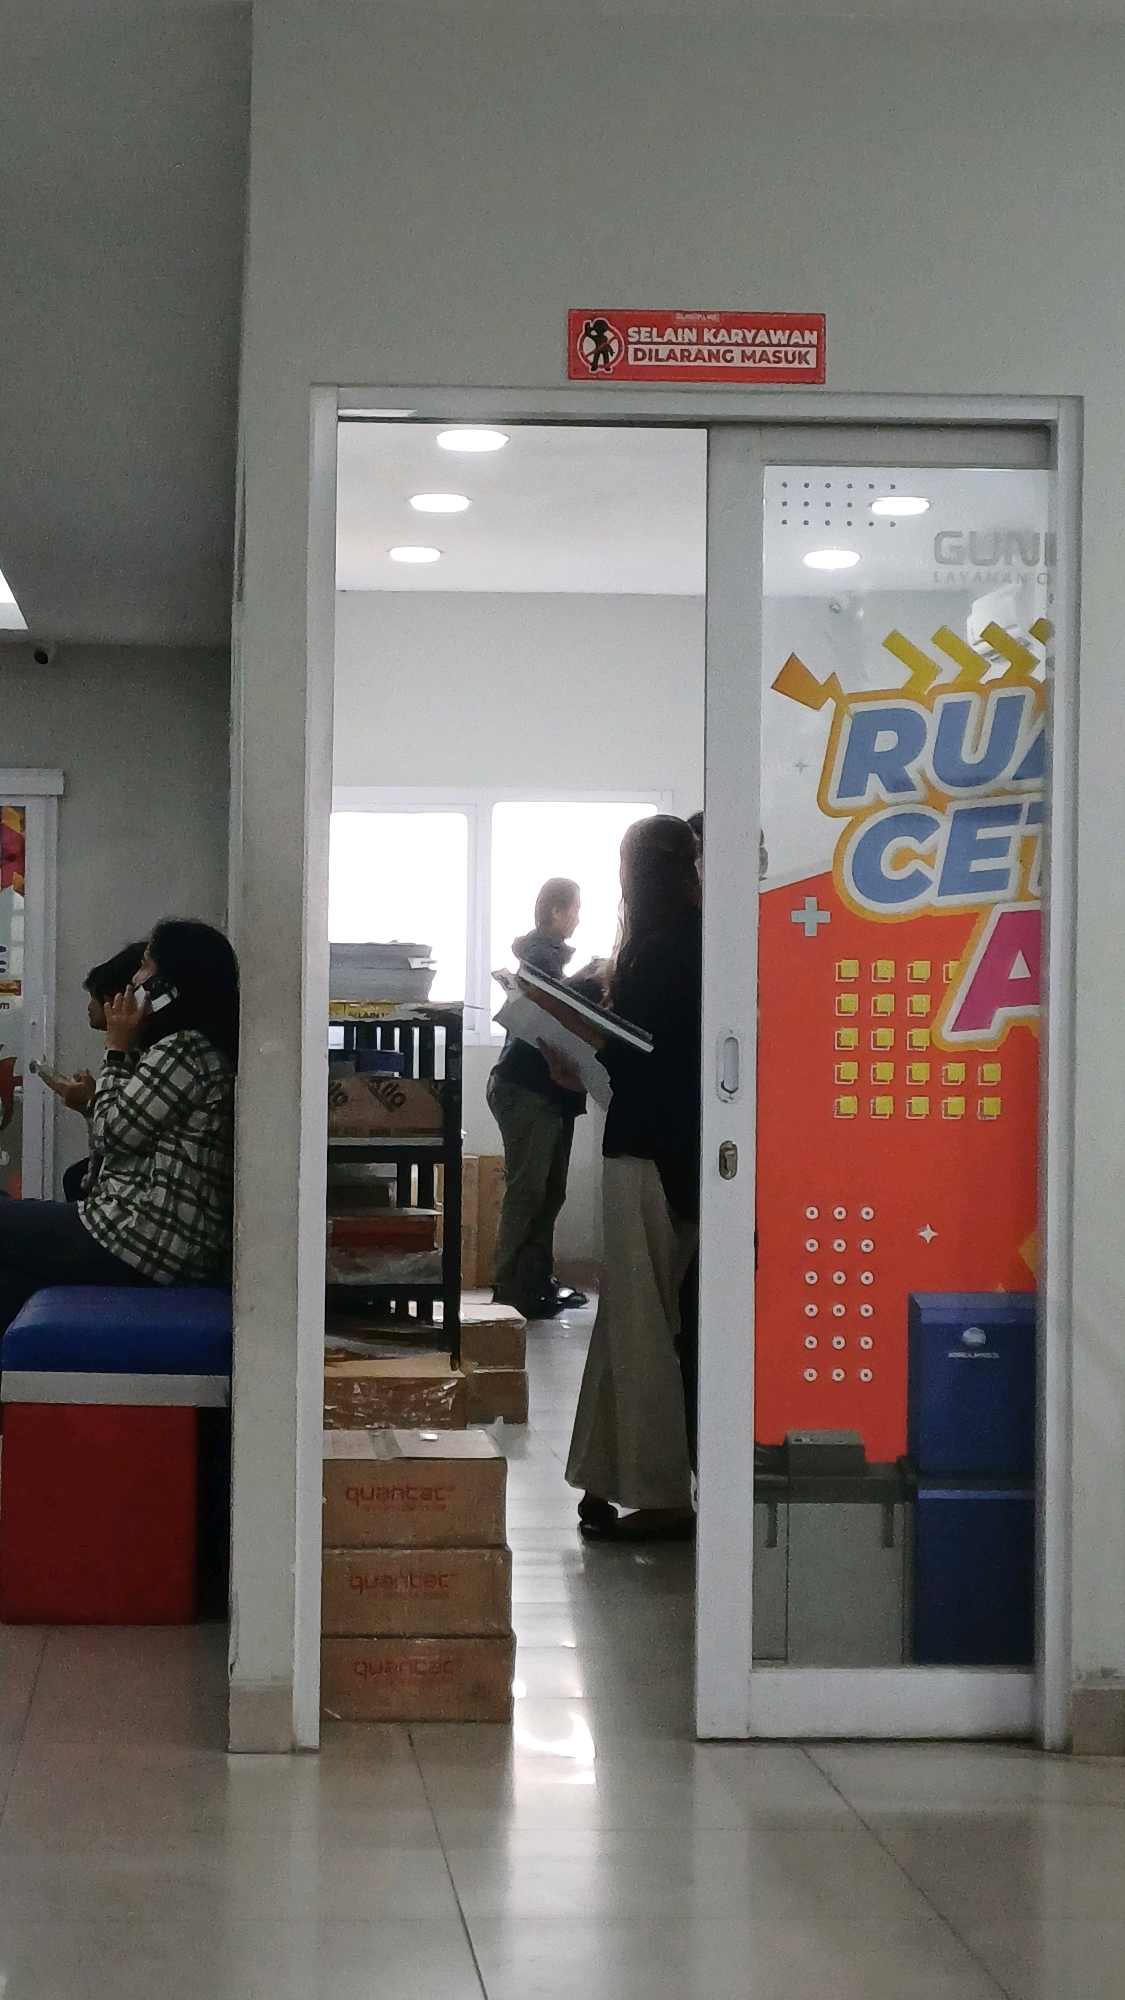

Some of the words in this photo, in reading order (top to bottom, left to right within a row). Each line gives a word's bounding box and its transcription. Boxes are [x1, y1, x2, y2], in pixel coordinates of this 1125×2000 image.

[627, 326, 698, 344] SELAIN
[703, 328, 818, 346] KARYAWAN
[633, 347, 735, 364] DILARANG
[740, 349, 811, 366] MASUK
[851, 801, 1045, 905] CE
